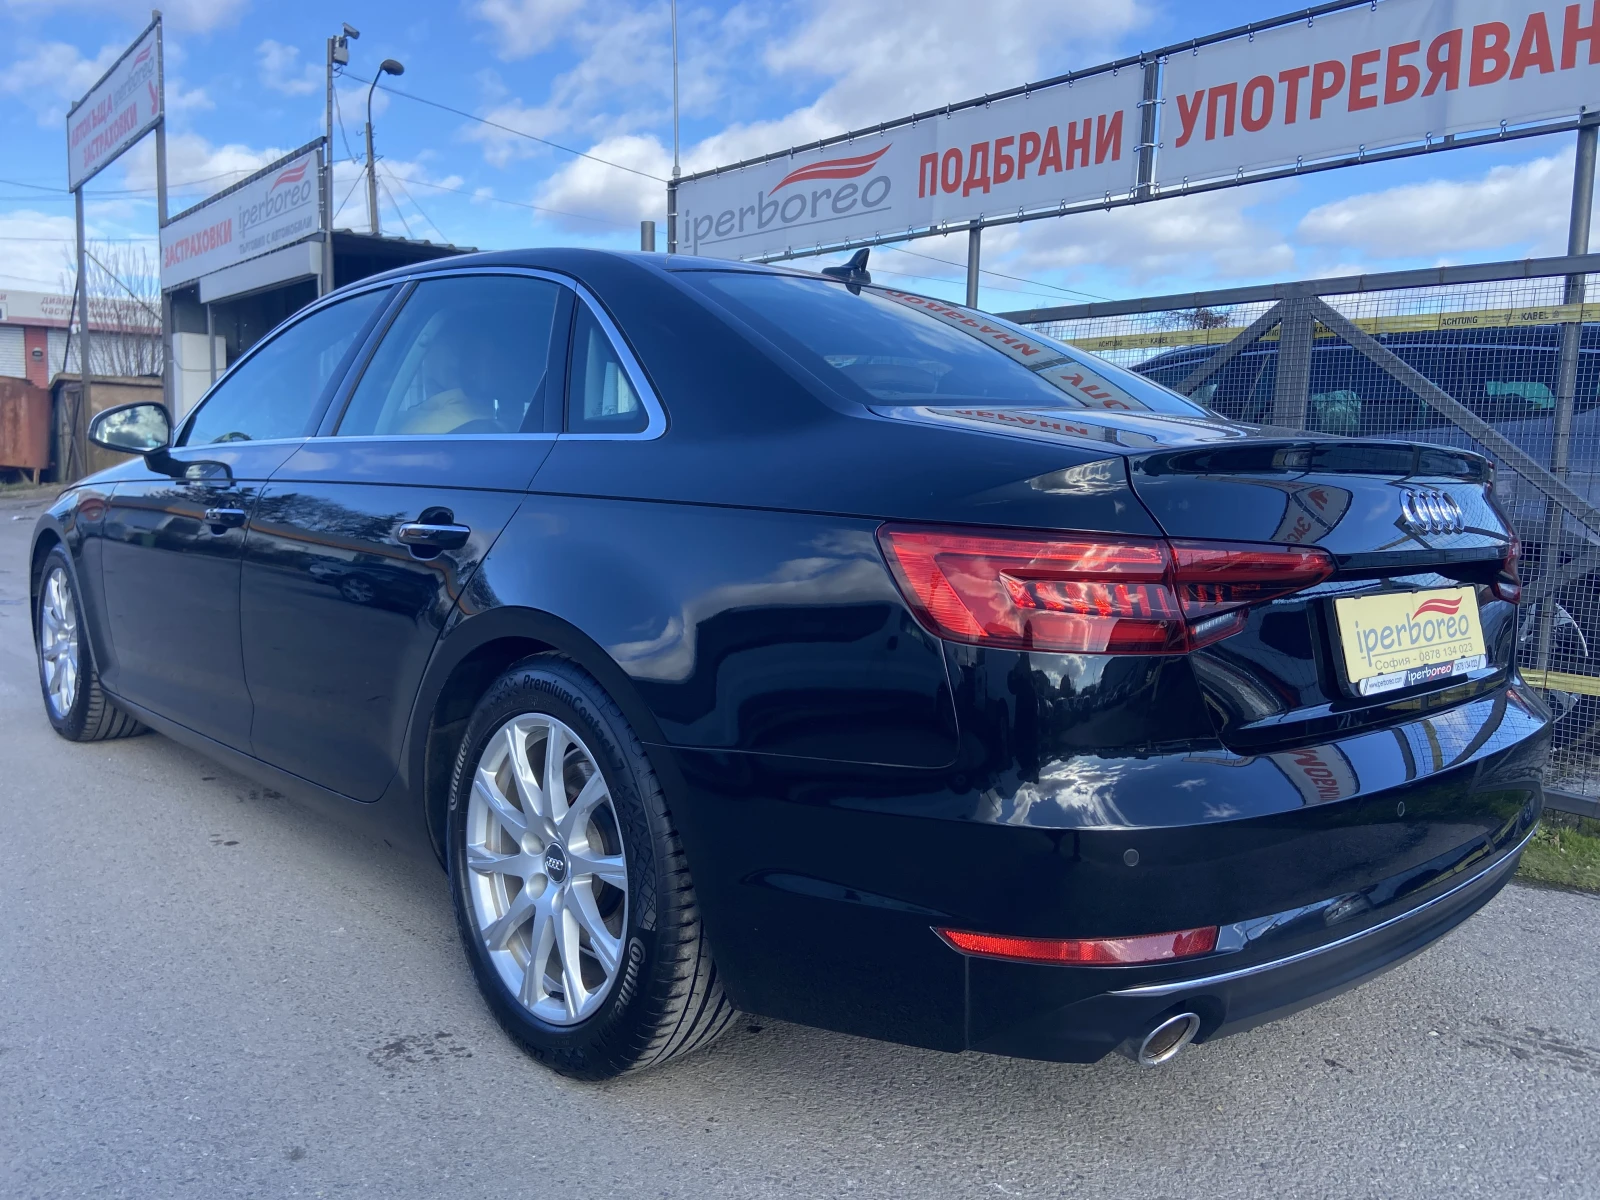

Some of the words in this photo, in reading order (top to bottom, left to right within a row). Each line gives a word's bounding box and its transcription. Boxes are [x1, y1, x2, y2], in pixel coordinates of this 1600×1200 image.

[1174, 0, 1600, 149] УПОТРЕБЯВАН
[917, 109, 1125, 199] ПОДБРАНИ
[238, 180, 312, 239] iperboreo
[684, 174, 892, 256] iperboreo
[164, 217, 233, 269] ЗАСТРАХОВКИ
[1441, 315, 1478, 327] ACHTUNG
[1520, 311, 1549, 321] KABEL
[1355, 613, 1470, 667] iperboreo
[1375, 657, 1411, 671] София
[1419, 648, 1441, 662] 0878
[1443, 645, 1457, 657] 134
[1459, 642, 1473, 654] 023
[1407, 663, 1453, 685] iperboreo
[522, 674, 616, 757] PremiumContact
